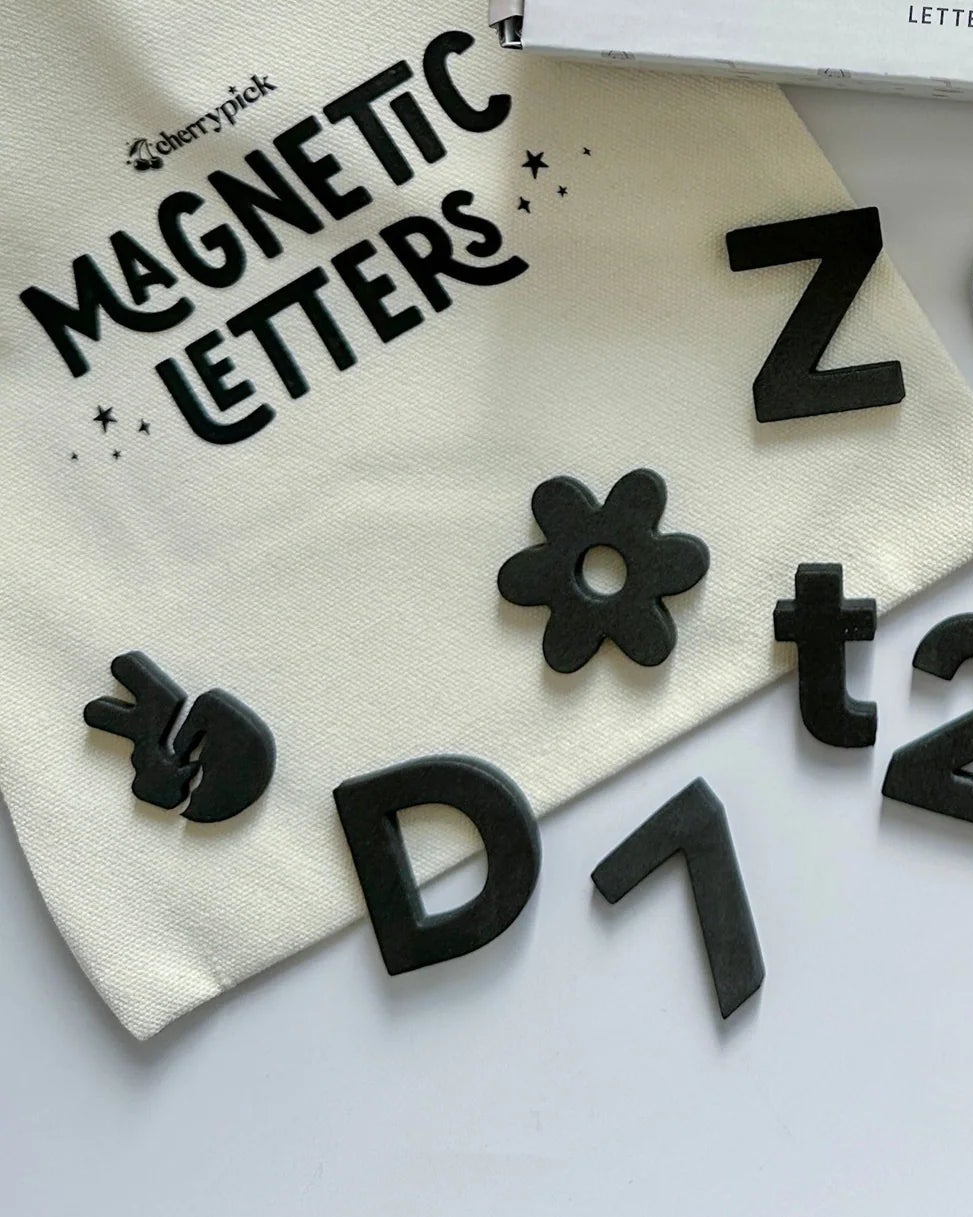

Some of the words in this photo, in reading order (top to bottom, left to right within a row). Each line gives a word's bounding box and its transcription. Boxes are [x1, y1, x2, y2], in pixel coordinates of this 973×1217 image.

[18, 30, 512, 379] MAGNETIC
[154, 73, 278, 157] cherrypick
[154, 189, 530, 446] LETTERS
